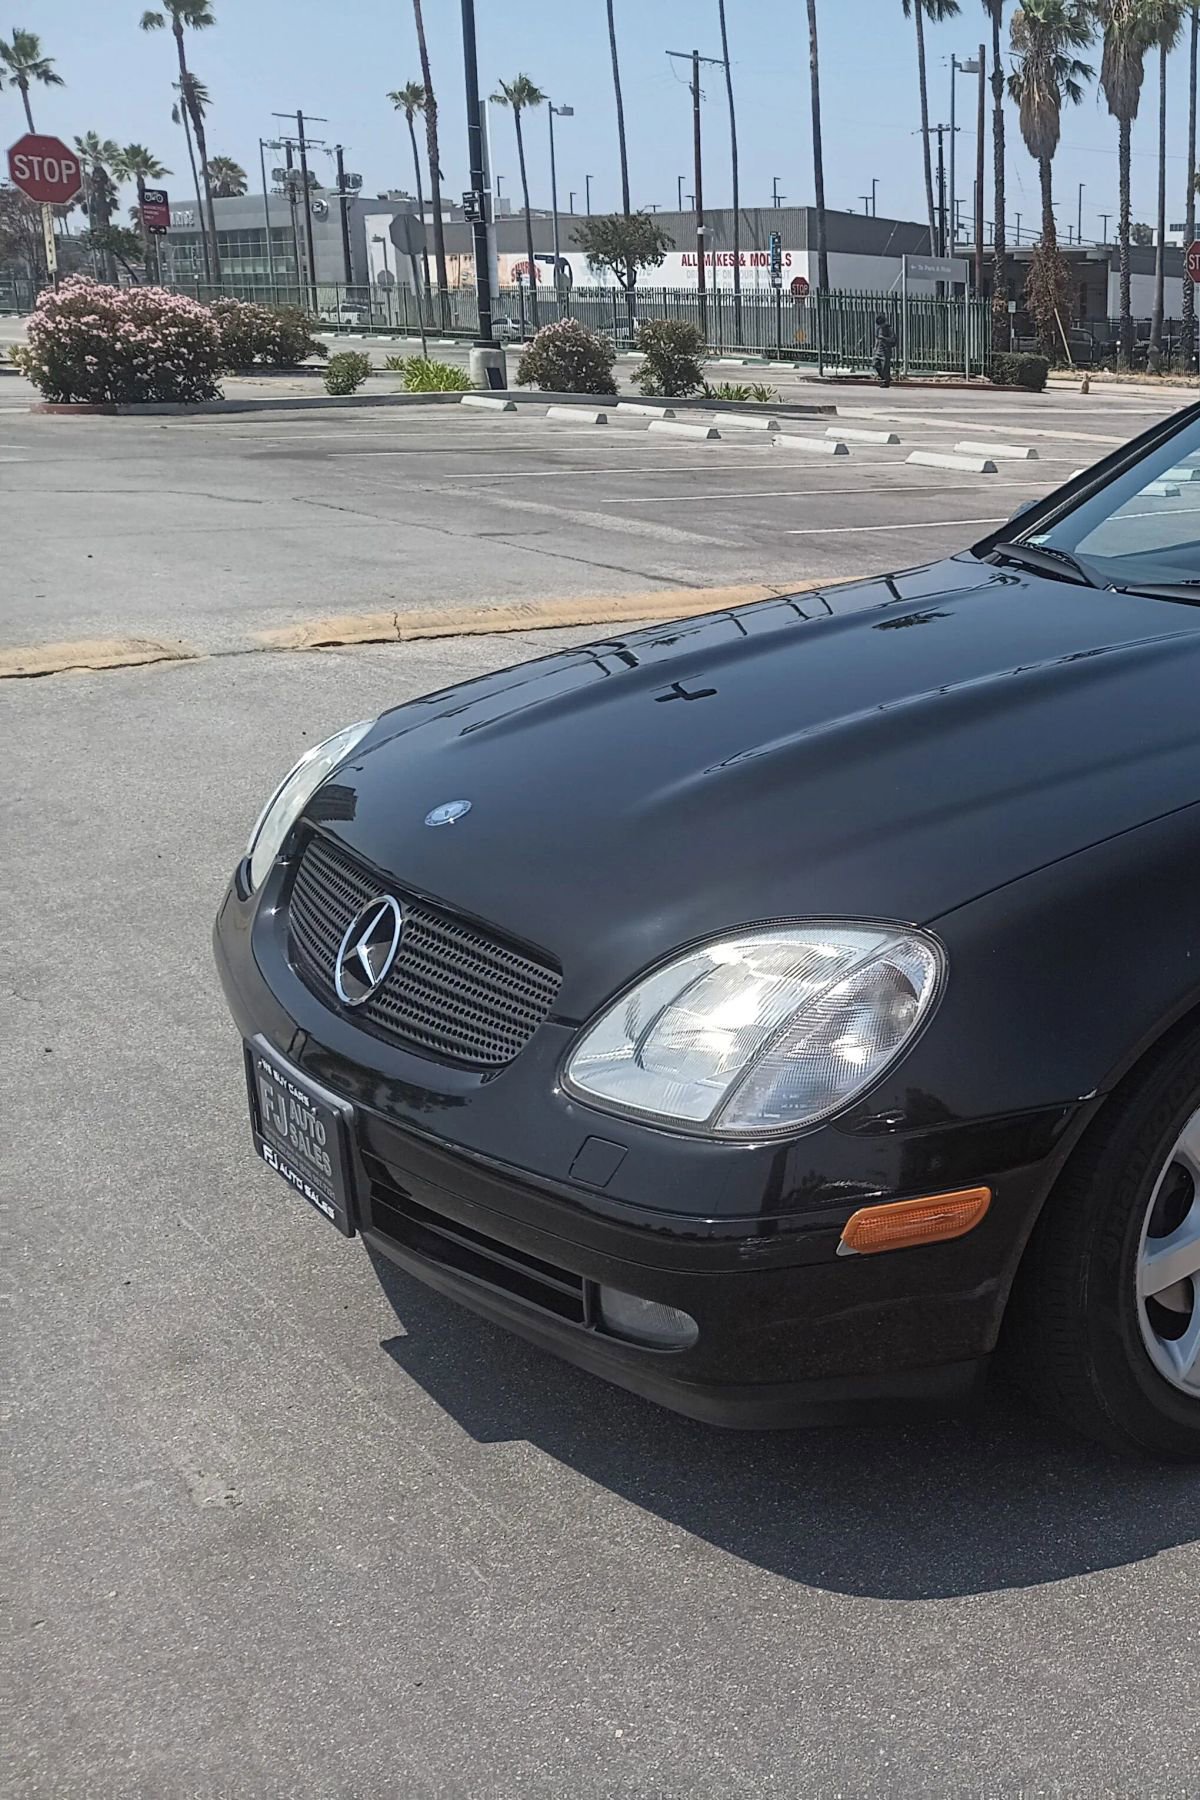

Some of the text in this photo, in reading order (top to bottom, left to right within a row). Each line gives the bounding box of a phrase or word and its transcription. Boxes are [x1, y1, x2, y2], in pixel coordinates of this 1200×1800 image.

[14, 154, 76, 184] STOP
[681, 253, 698, 266] ALL
[739, 252, 746, 266] &
[792, 283, 808, 295] STOP
[273, 1069, 287, 1088] BUY
[288, 1083, 310, 1107] CARS
[259, 1075, 326, 1146] FJ AUTO
[289, 1122, 332, 1177] SALES
[263, 1143, 335, 1219] FJ AUTO SALES
